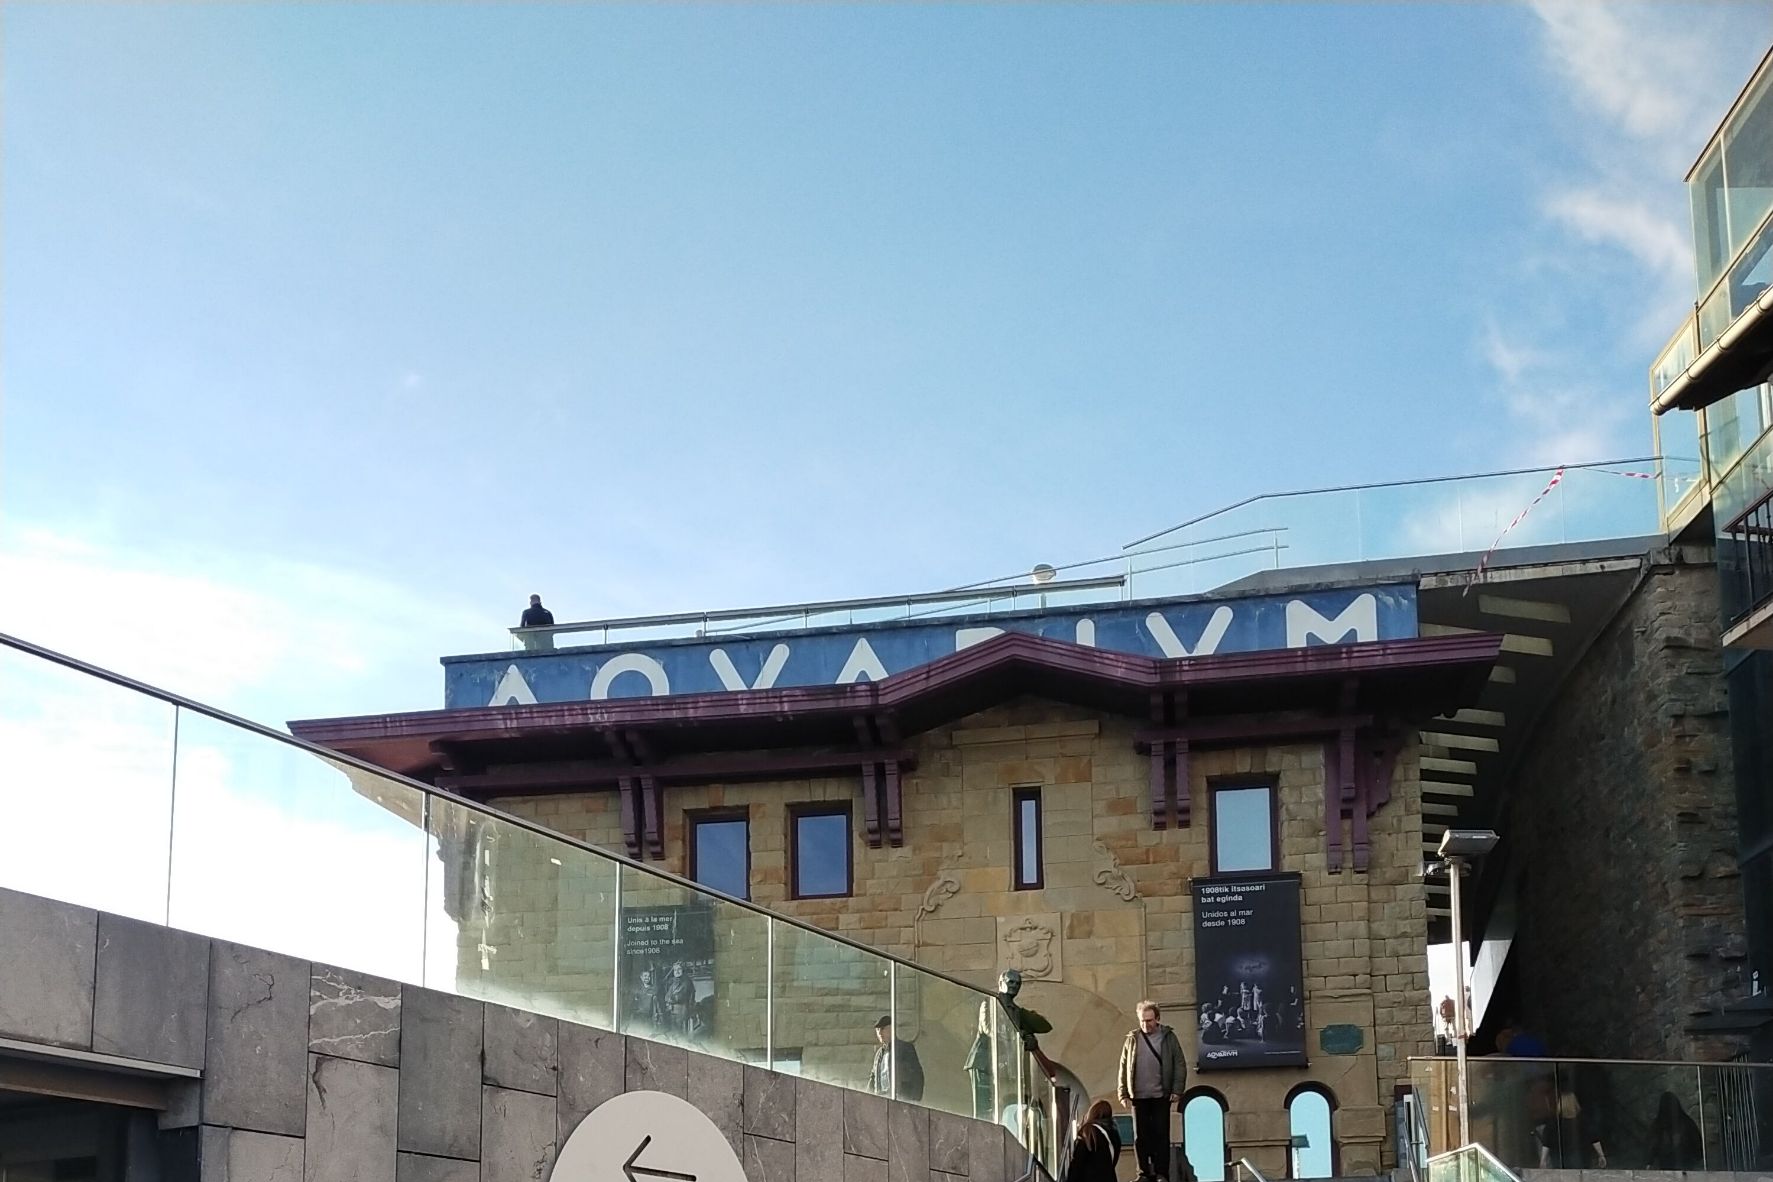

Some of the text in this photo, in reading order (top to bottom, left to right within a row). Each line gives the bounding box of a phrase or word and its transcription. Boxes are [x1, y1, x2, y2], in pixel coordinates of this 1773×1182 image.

[1201, 884, 1265, 894] 1908tik itsasoari
[1216, 894, 1243, 903] eginda
[1202, 910, 1228, 918] Unidos
